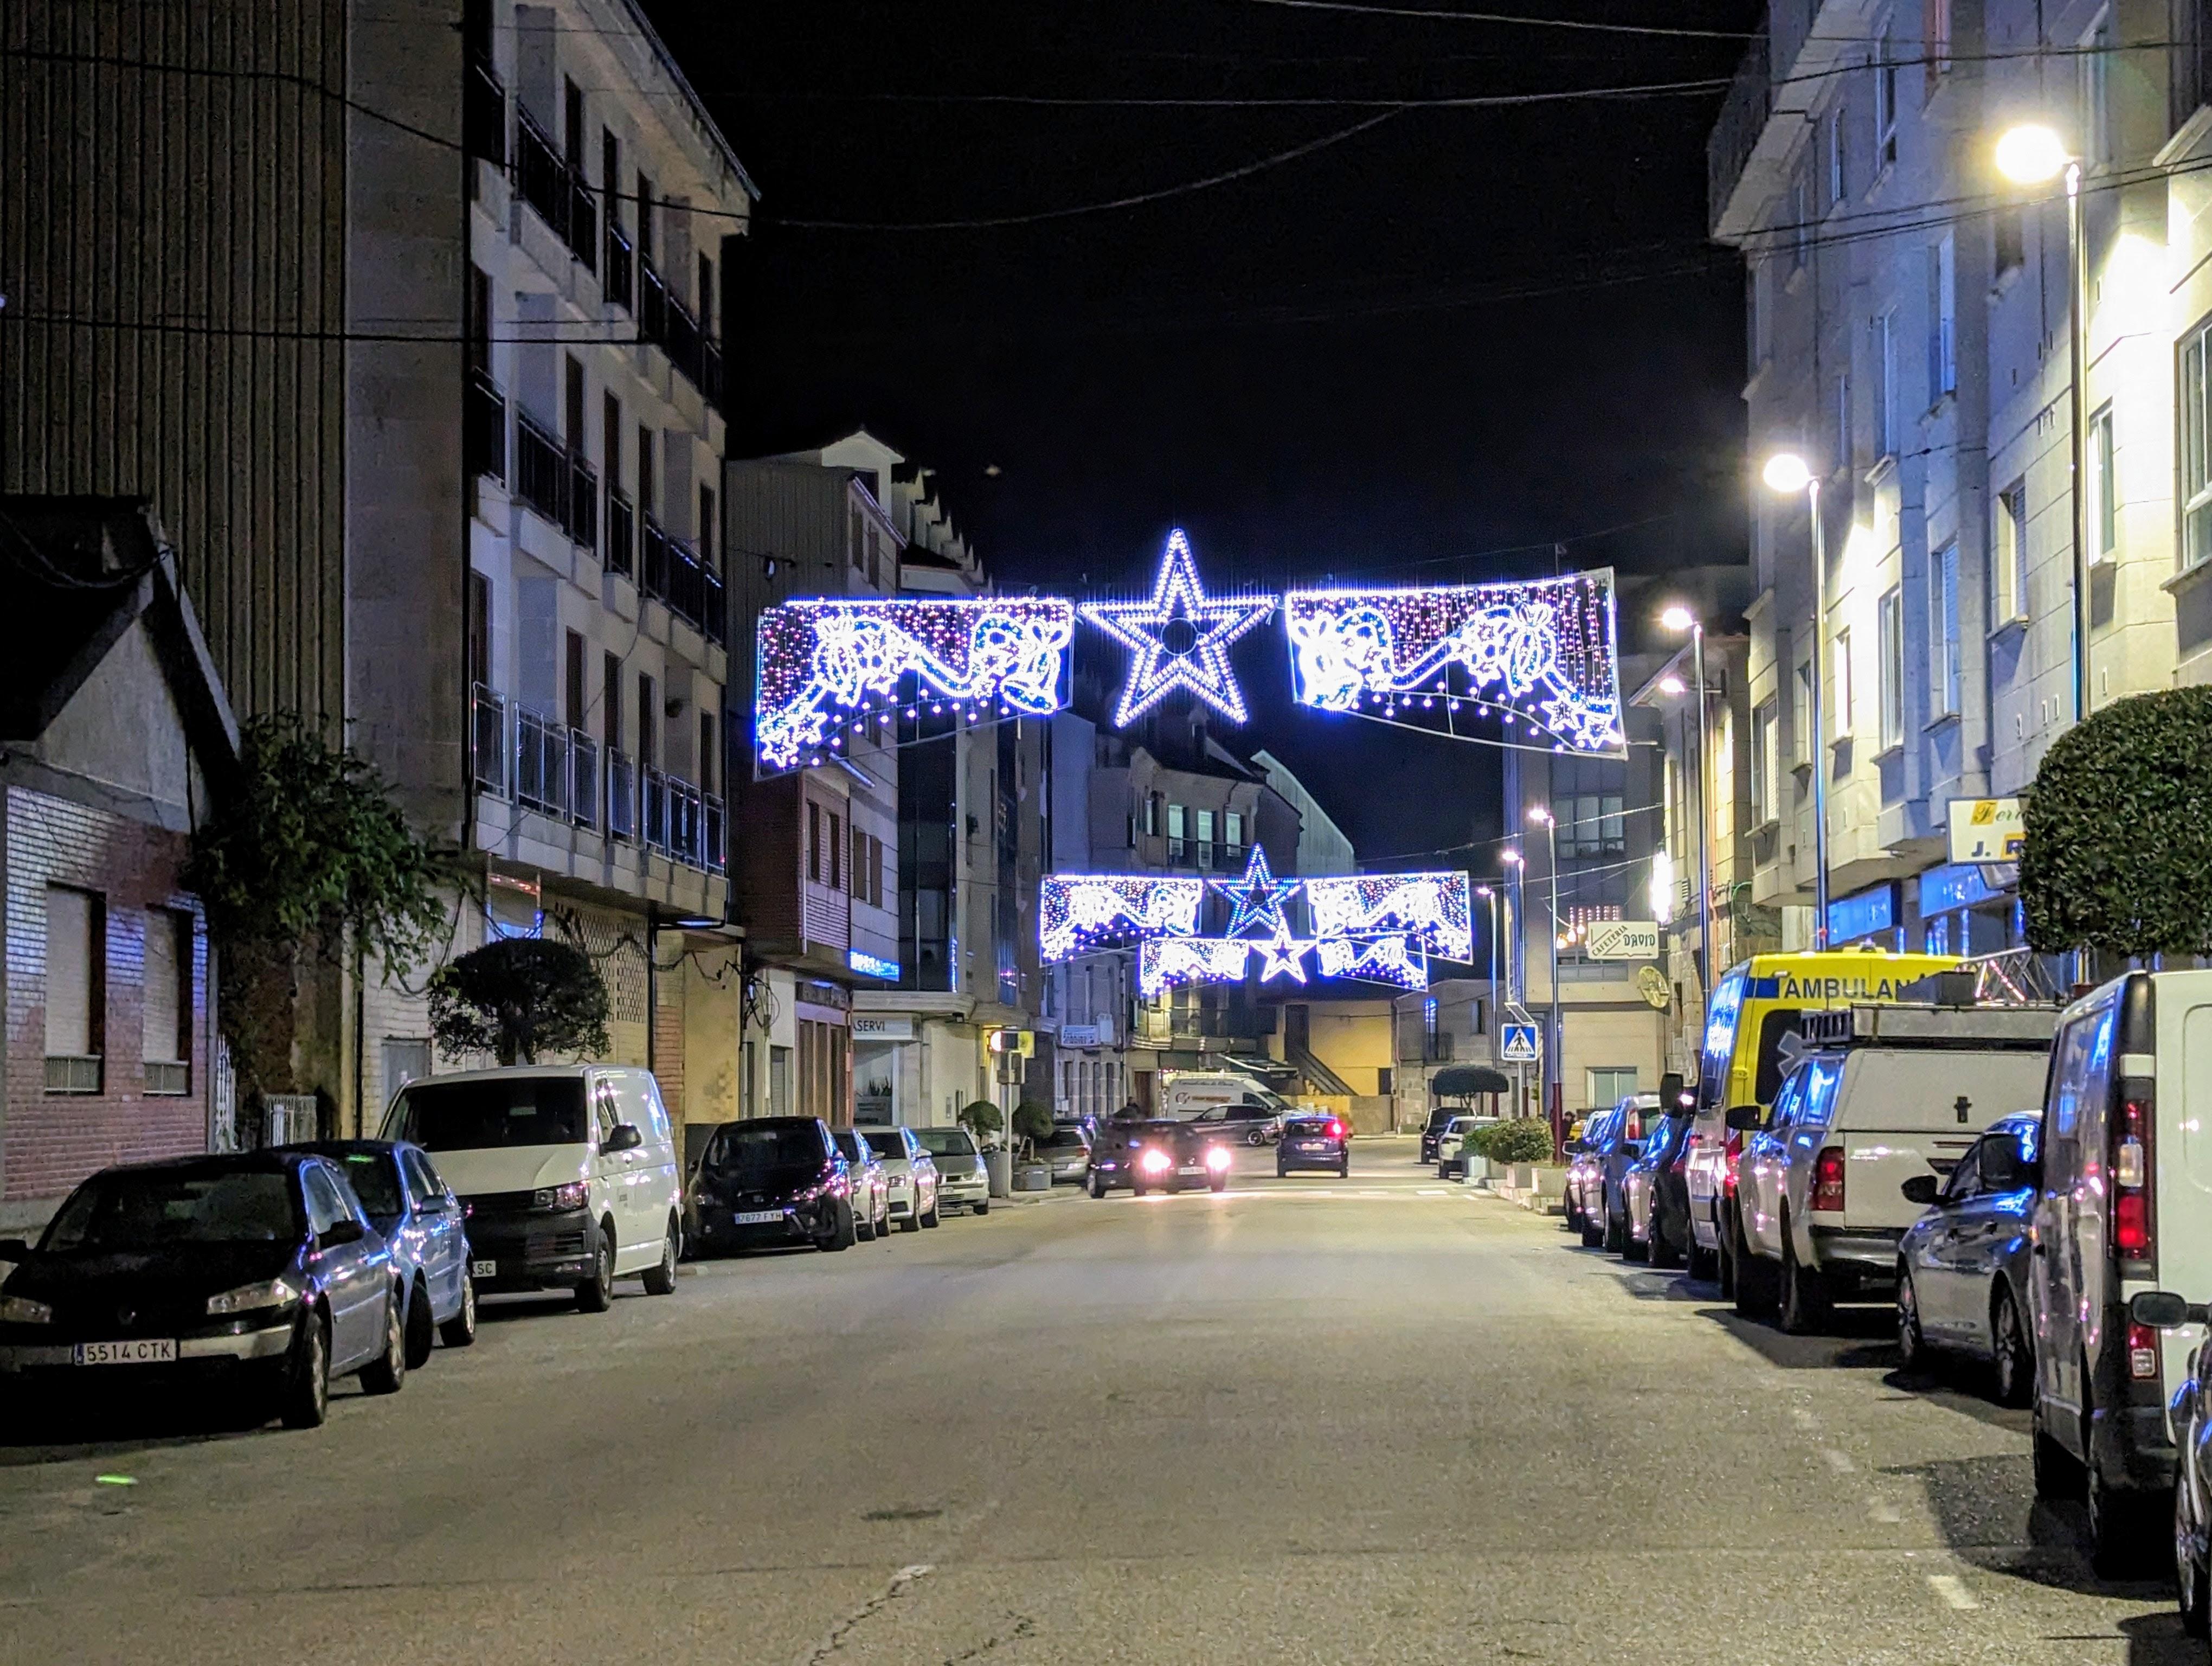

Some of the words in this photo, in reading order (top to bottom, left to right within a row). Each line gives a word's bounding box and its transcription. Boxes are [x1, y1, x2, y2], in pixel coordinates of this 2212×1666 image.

[1592, 925, 1628, 956] CAFETERIA
[1623, 934, 1655, 947] DAVID
[87, 1344, 131, 1362] 5514
[138, 1342, 170, 1359] CTK
